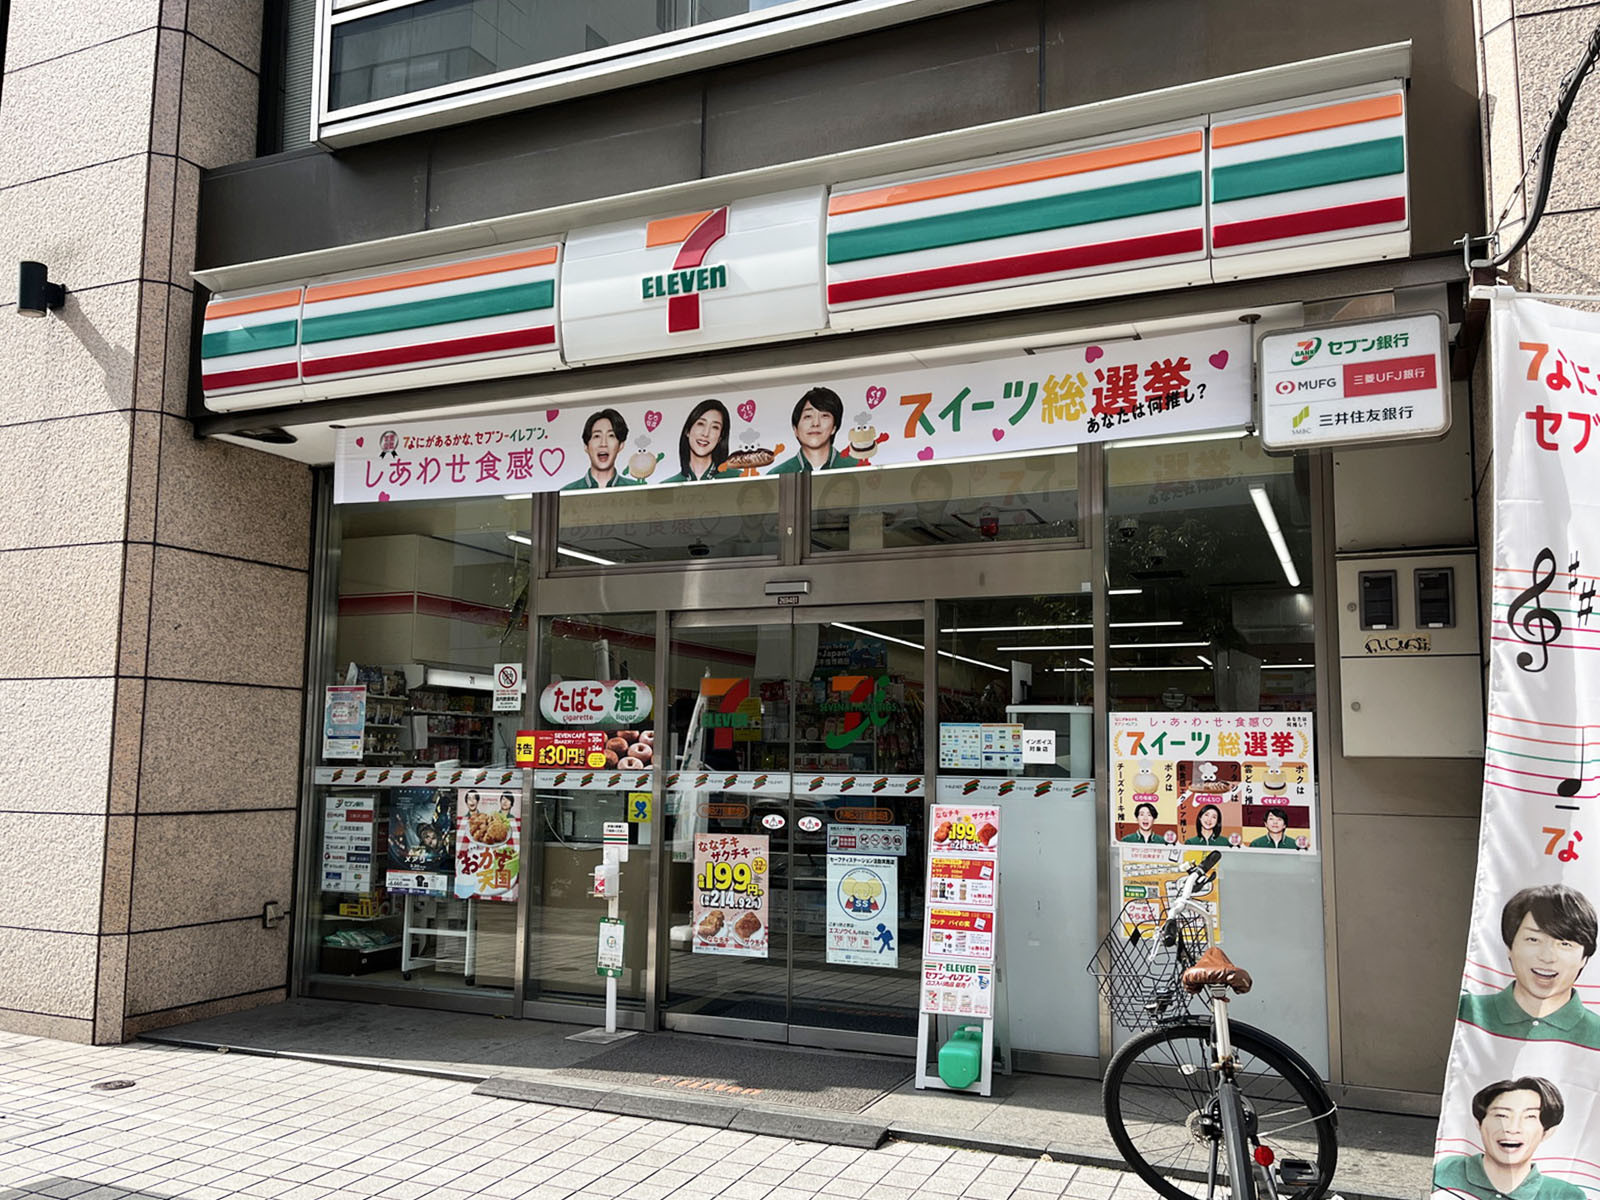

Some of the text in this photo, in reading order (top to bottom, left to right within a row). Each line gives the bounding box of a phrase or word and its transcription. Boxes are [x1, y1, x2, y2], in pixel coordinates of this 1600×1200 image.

[1327, 332, 1410, 356] セブン銀行
[1297, 377, 1337, 391] MUFG
[1353, 367, 1426, 386] 三菱UFJ銀行
[899, 356, 1192, 439] スイーツ総選挙
[1319, 405, 1414, 428] 三井住友銀行
[553, 686, 604, 712] たばこ
[613, 686, 638, 712] 酒
[562, 713, 594, 722] cigarette
[615, 714, 636, 722] liquor
[697, 836, 740, 853] ななチキ
[710, 847, 751, 863] ザクチキ
